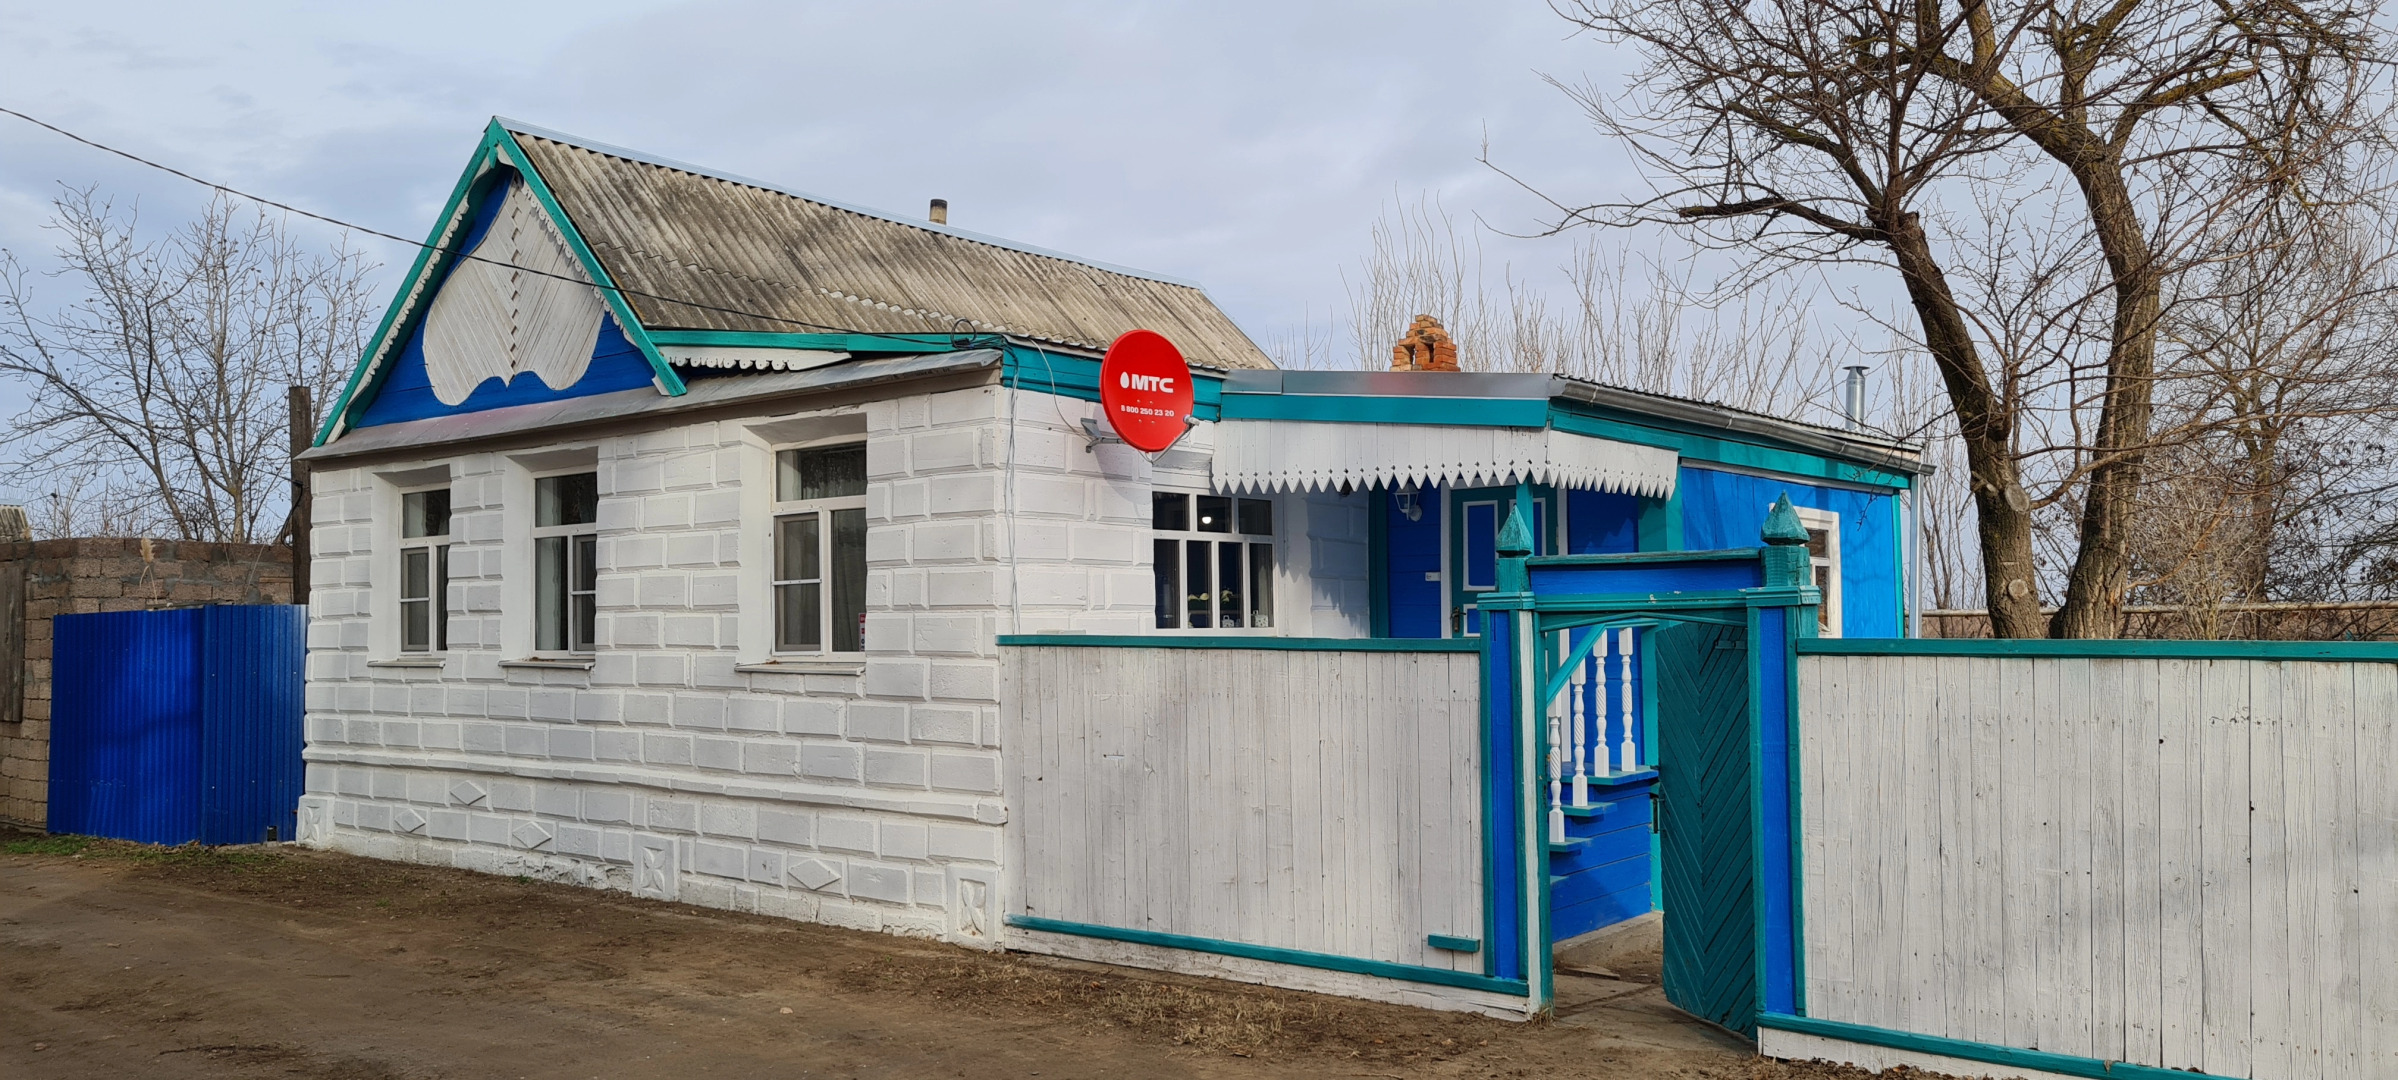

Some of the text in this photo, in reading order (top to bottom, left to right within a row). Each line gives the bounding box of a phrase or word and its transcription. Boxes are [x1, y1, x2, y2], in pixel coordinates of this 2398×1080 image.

[1131, 374, 1174, 393] МТС
[1126, 405, 1139, 413] 800
[1140, 407, 1153, 415] 250
[1165, 409, 1174, 417] 20
